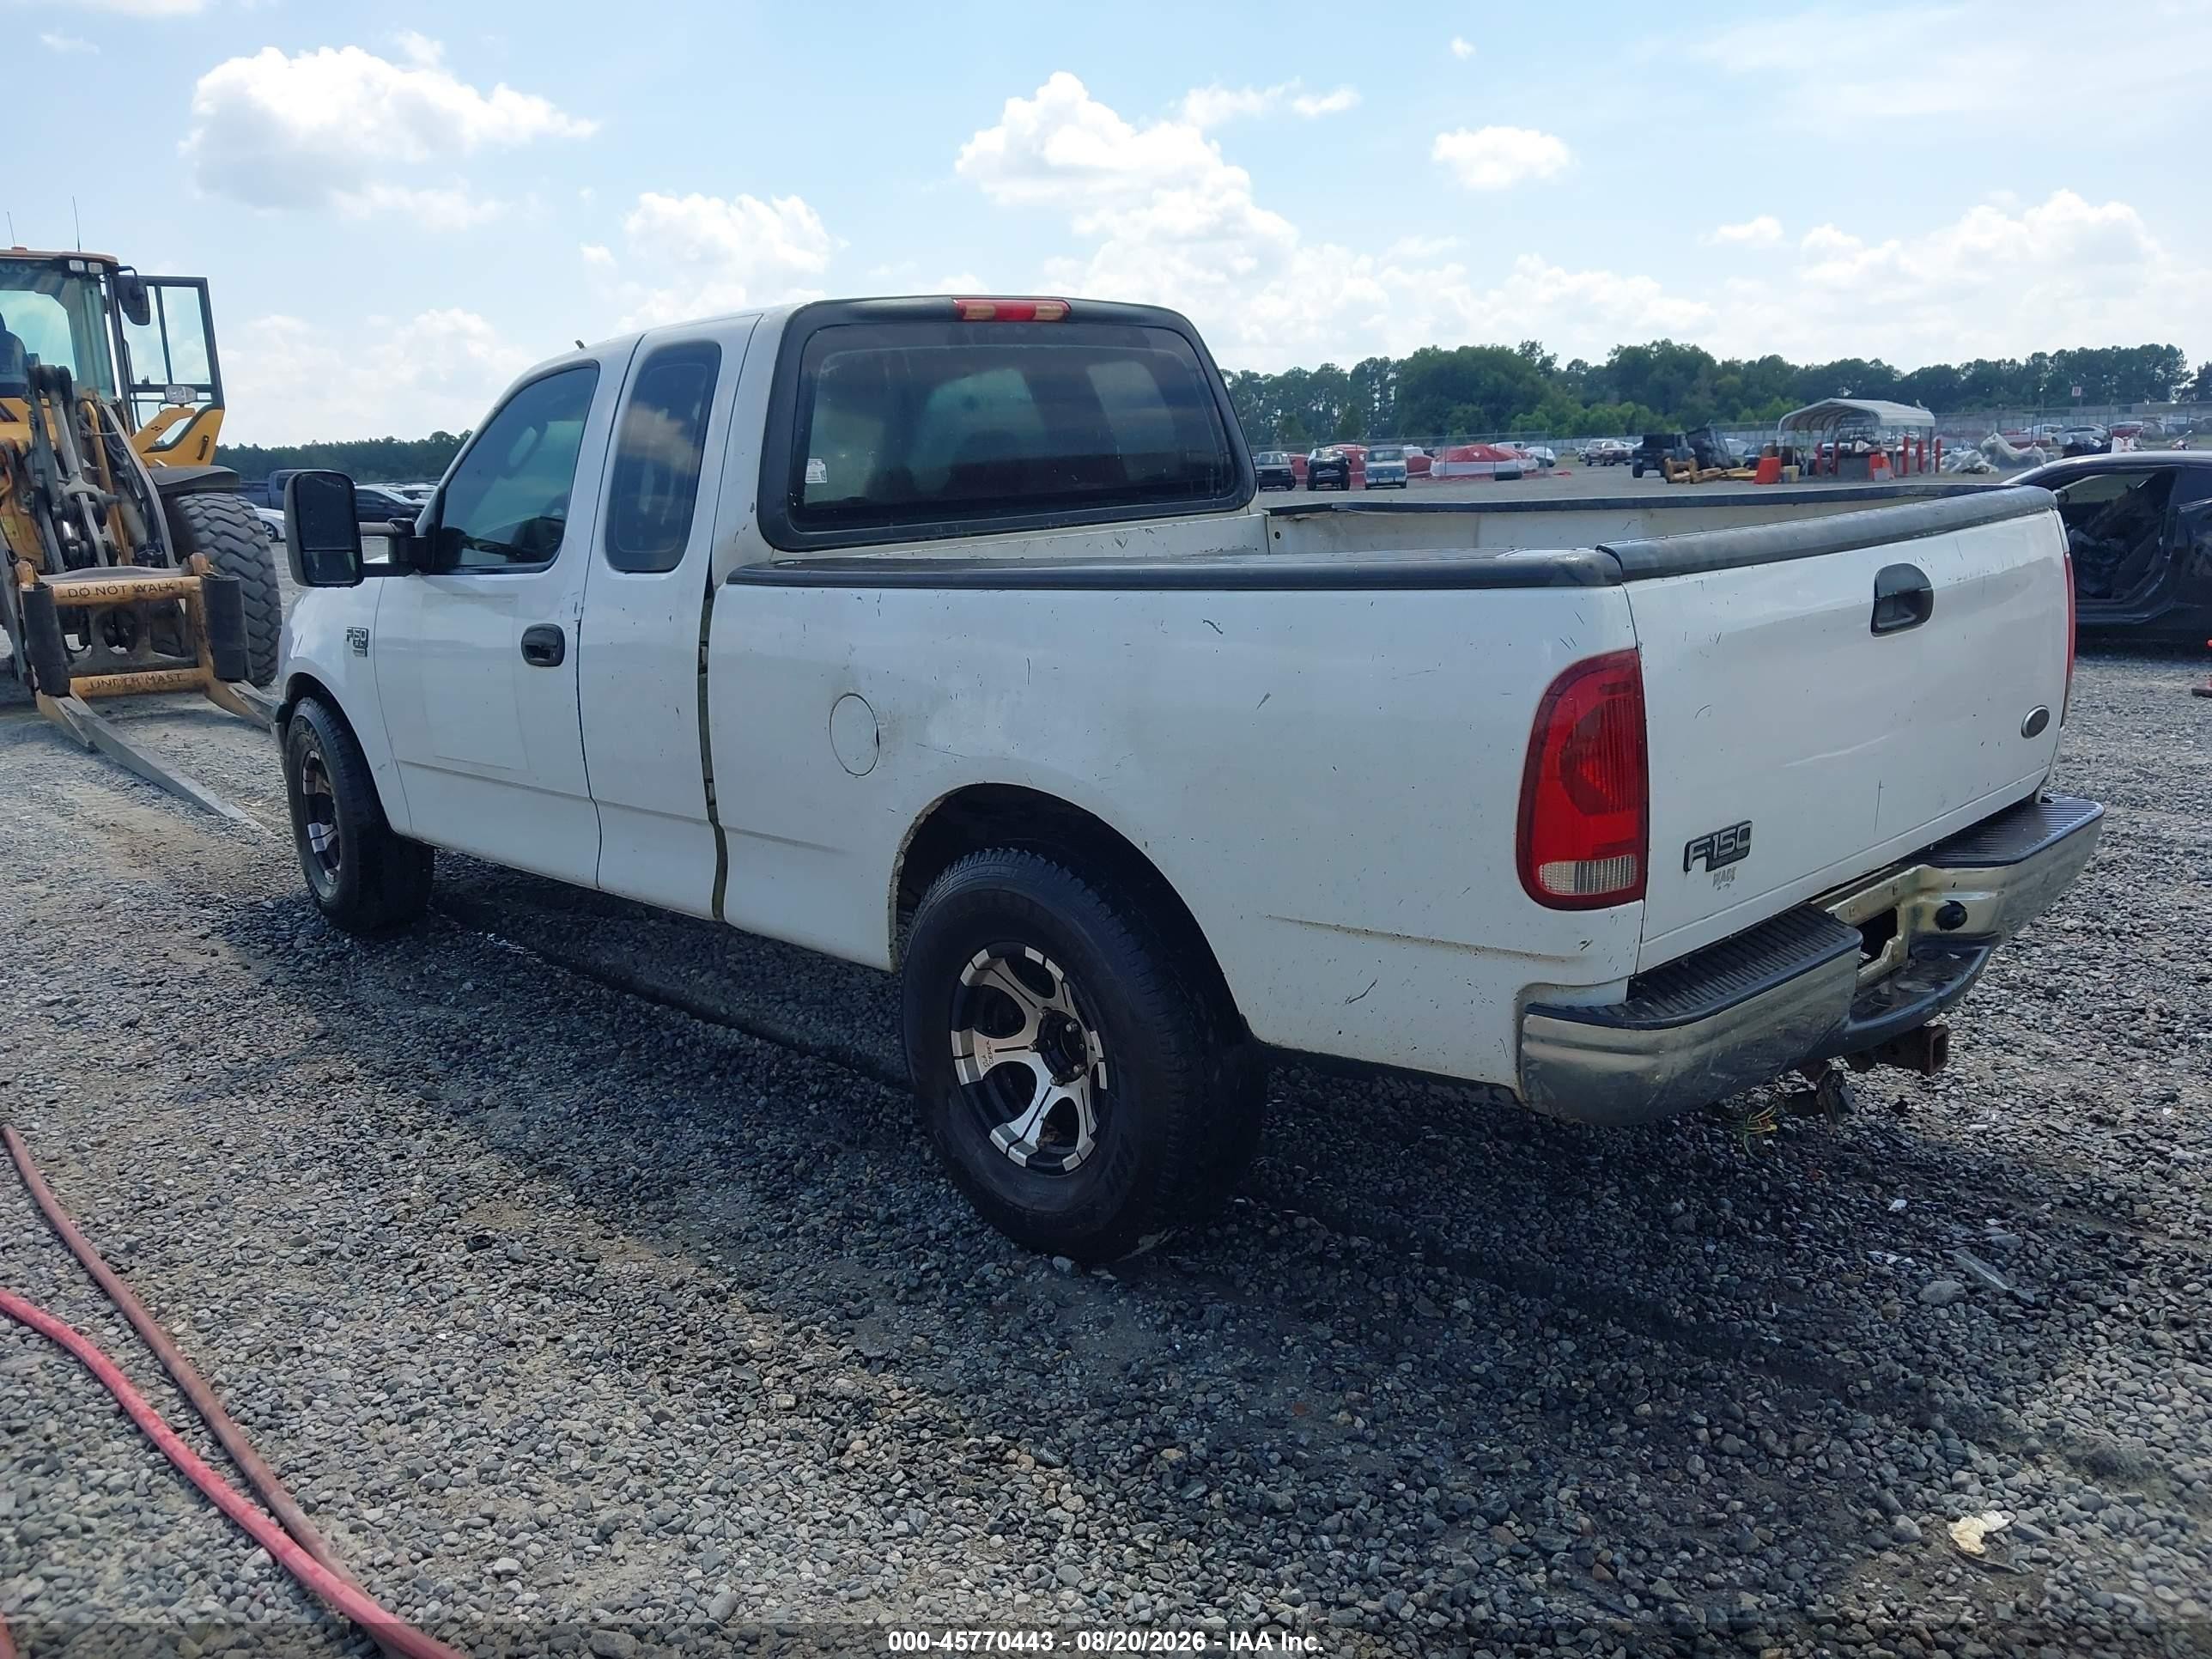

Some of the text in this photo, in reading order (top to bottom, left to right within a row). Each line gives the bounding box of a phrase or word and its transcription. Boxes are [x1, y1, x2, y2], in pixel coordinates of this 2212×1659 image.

[68, 587, 90, 599] DO
[95, 585, 126, 597] NOT
[131, 582, 175, 592] WALK
